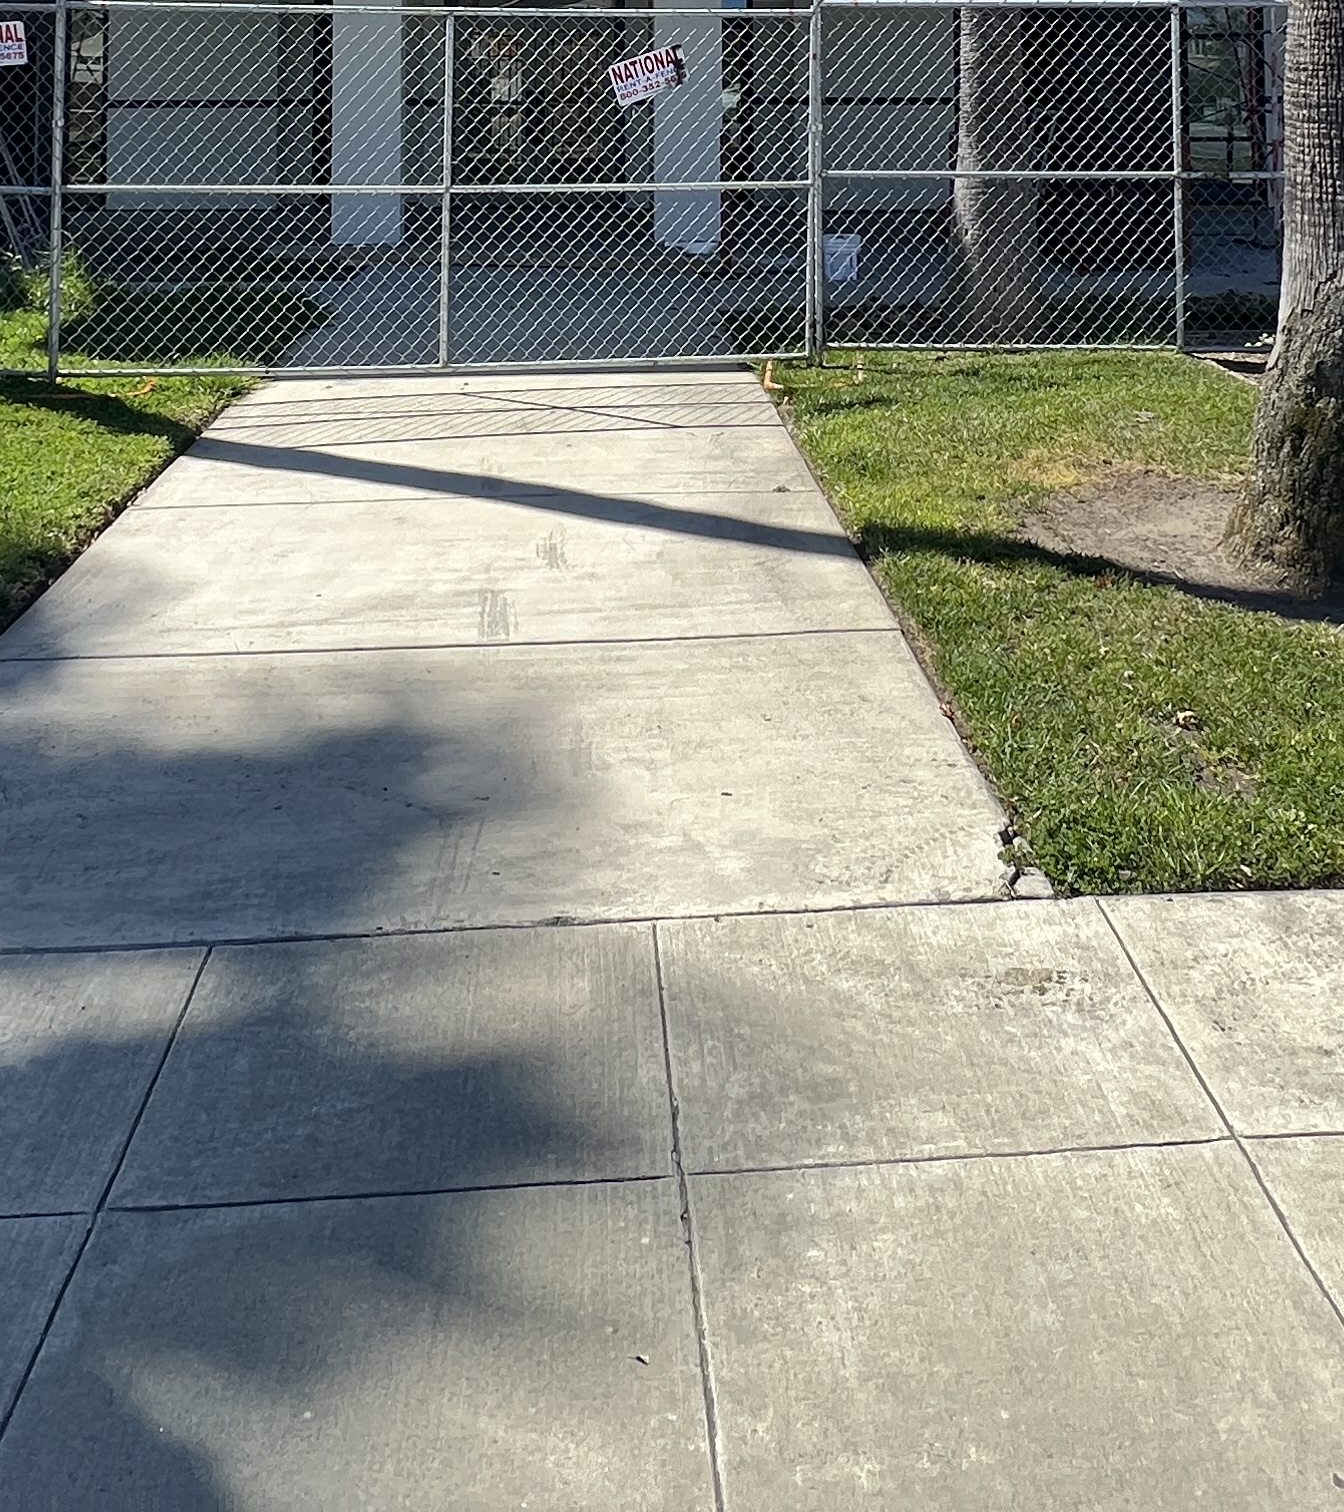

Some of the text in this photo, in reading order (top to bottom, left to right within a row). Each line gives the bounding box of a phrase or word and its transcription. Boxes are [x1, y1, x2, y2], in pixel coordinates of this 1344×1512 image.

[611, 46, 682, 86] NATIONAL
[616, 67, 679, 93] RENT-A-FENC
[619, 70, 688, 101] 800-352-565
